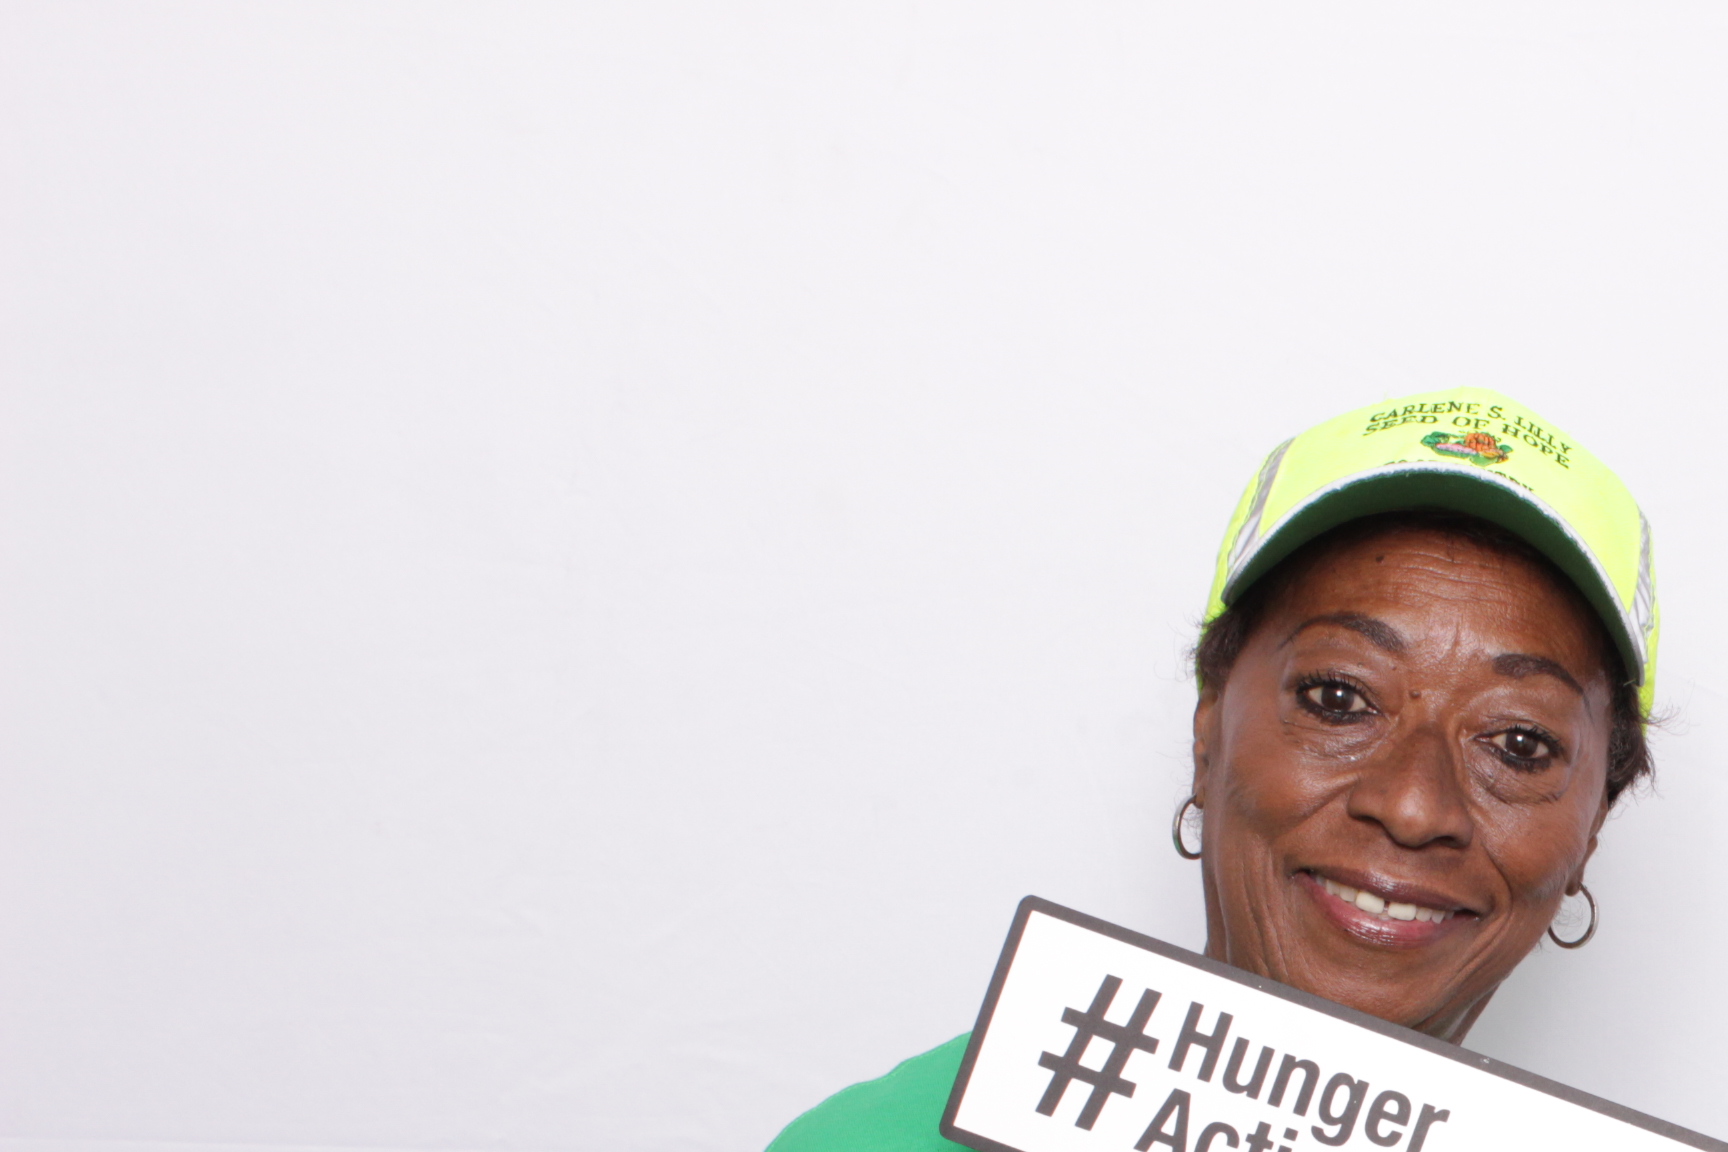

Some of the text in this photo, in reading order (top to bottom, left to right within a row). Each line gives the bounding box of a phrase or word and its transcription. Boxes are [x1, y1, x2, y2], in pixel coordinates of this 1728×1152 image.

[1363, 415, 1570, 469] SEED OF HOPE
[1514, 415, 1573, 455] LILLY
